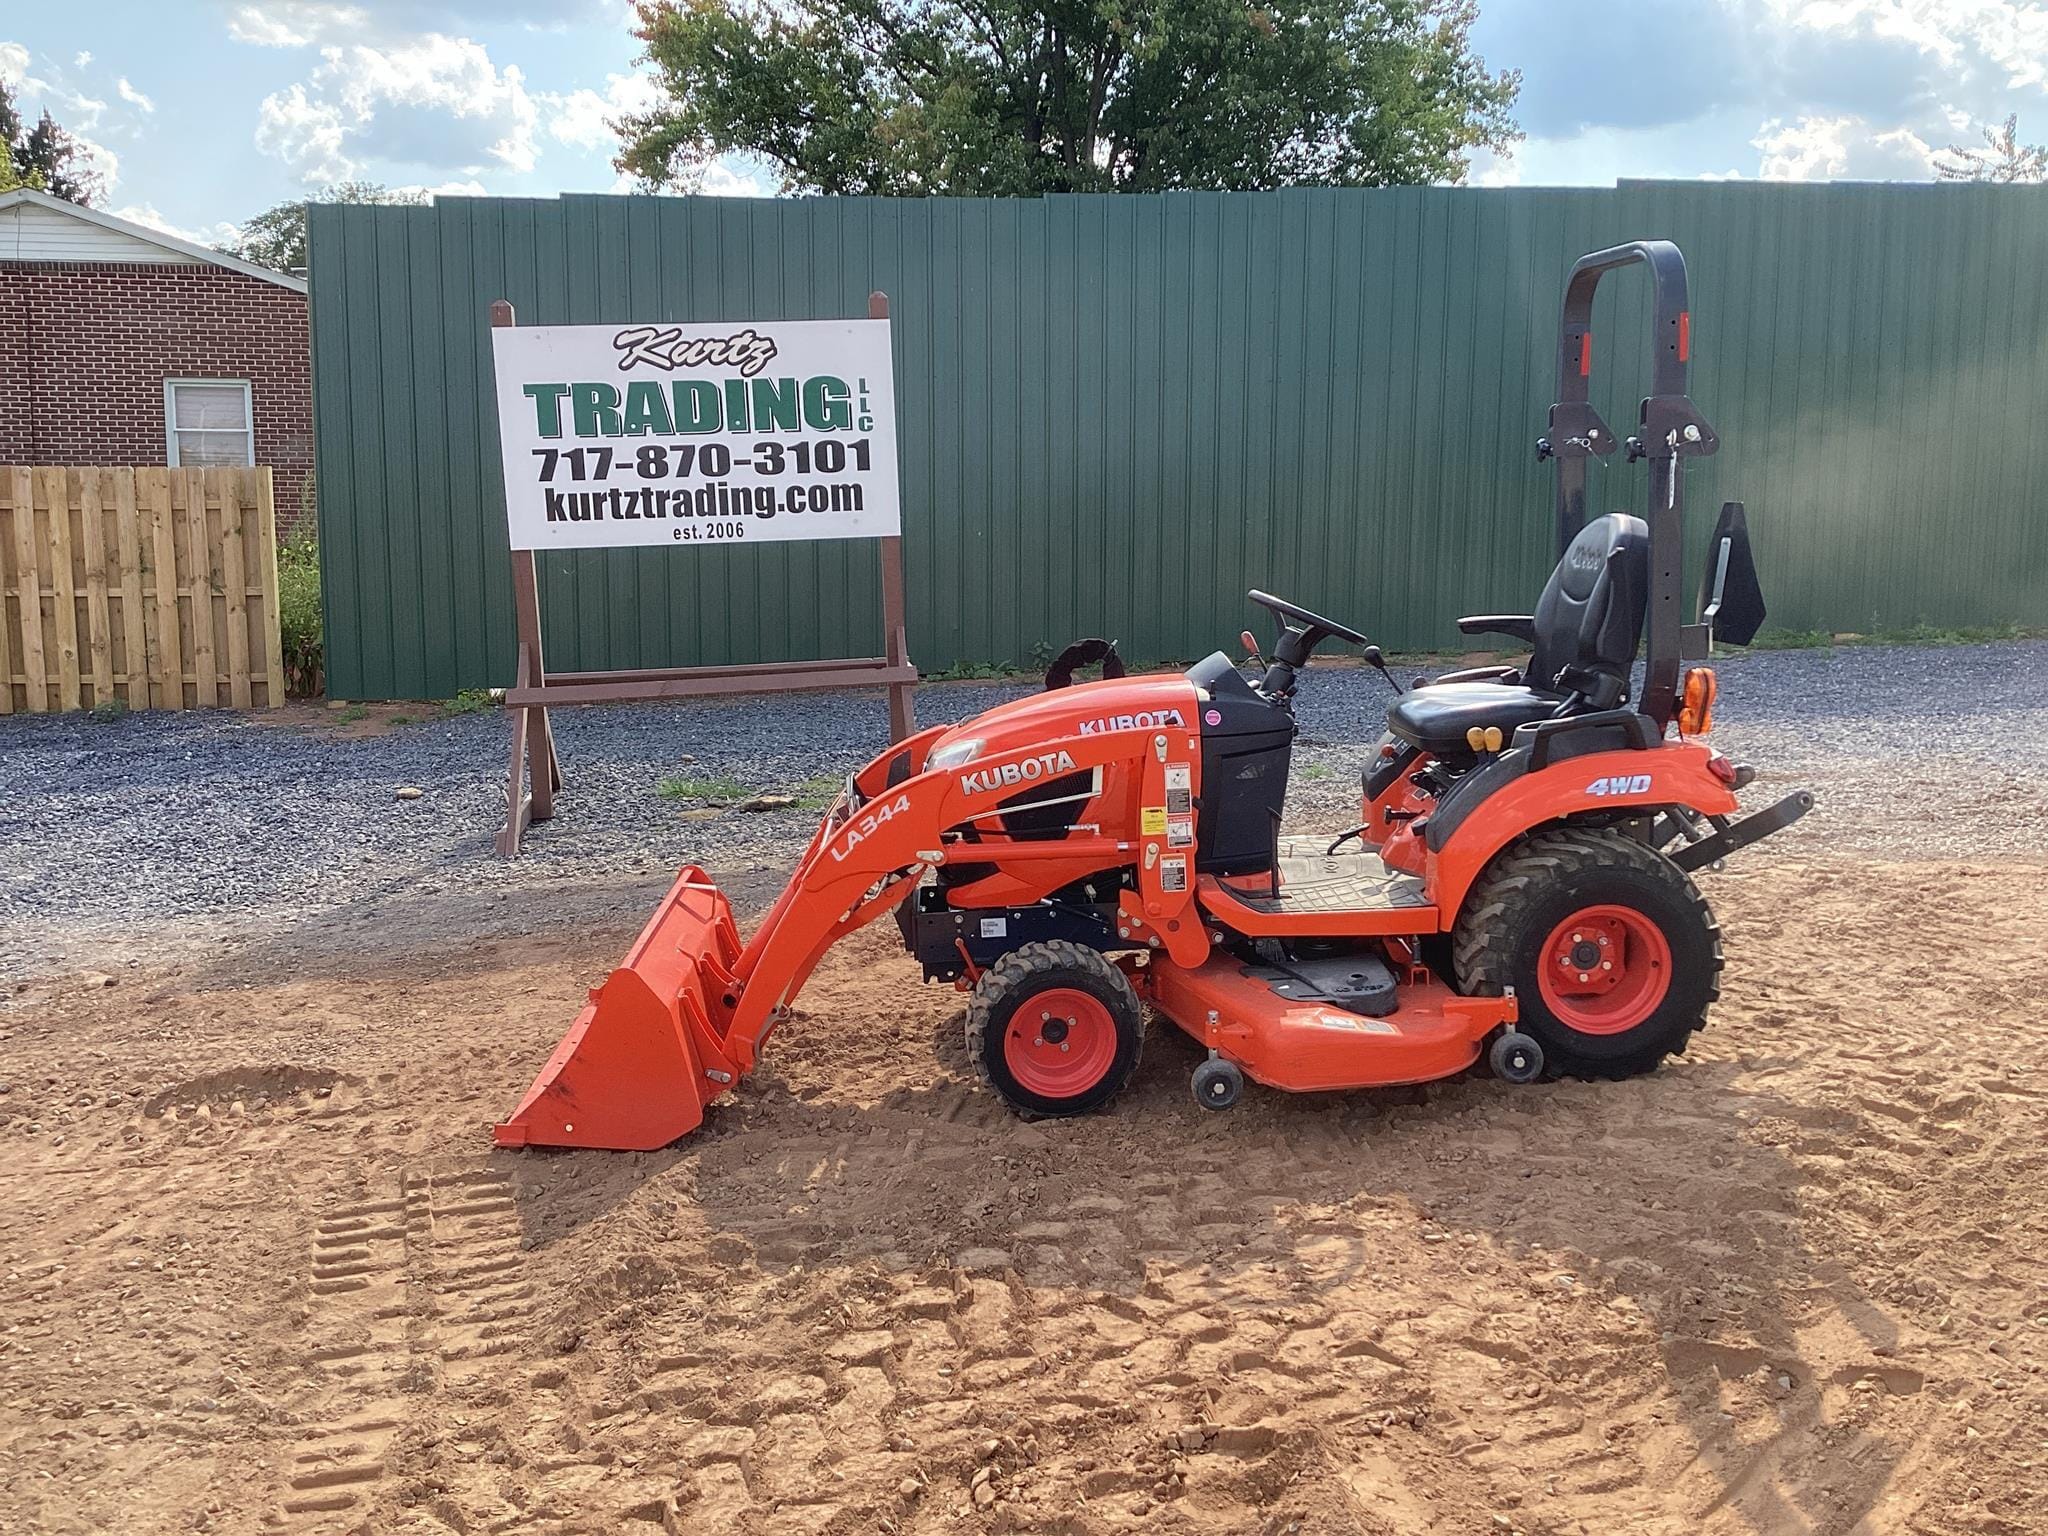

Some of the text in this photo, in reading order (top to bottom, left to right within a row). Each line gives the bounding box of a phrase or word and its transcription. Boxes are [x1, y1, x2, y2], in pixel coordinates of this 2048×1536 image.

[613, 327, 777, 377] Kurtz
[523, 375, 853, 439] TRADING
[858, 378, 873, 432] LLC
[532, 438, 872, 482] 717-870-3101
[545, 481, 864, 522] kurtztrading.com
[673, 522, 744, 540] est. 2006
[1079, 708, 1187, 735] KUBOTA
[960, 750, 1077, 796] KUBOTA
[1585, 774, 1652, 796] 4WD
[831, 794, 911, 862] LA344
